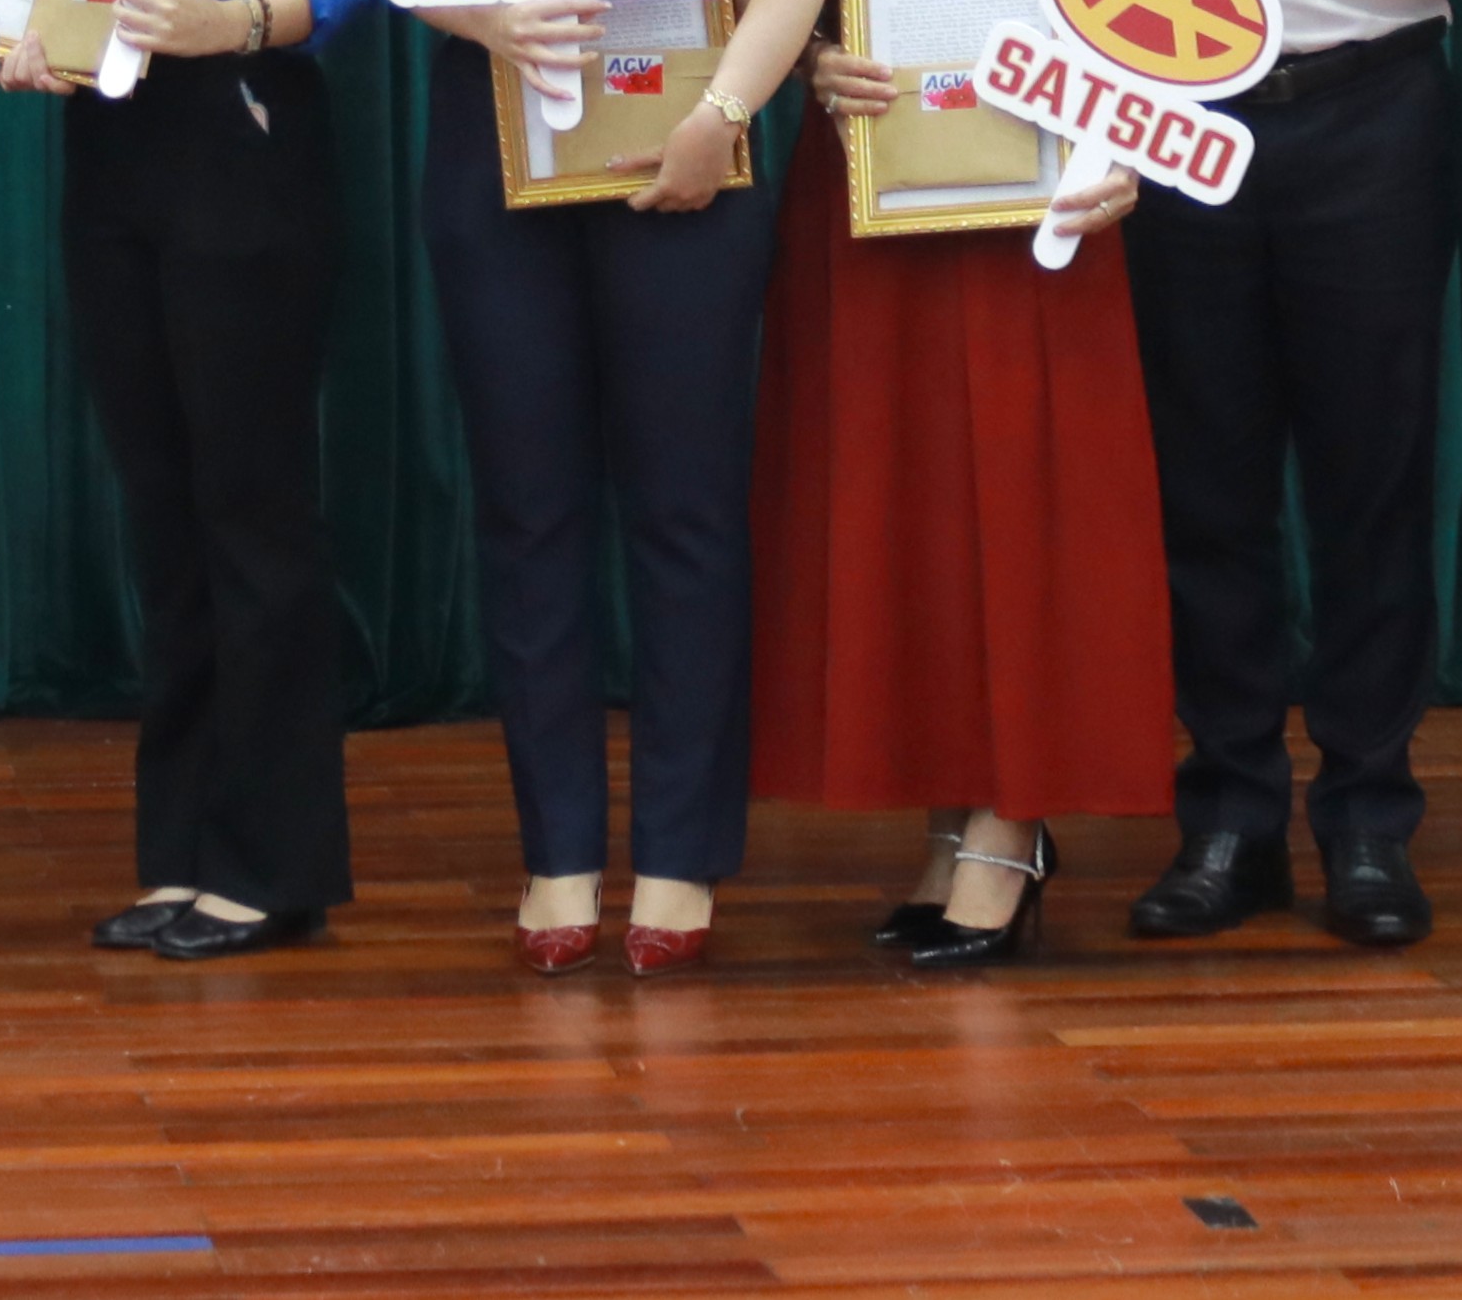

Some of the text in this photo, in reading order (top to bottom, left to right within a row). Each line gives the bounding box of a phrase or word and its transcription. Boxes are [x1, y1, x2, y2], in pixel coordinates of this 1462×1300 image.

[607, 57, 652, 74] ACV
[924, 72, 968, 91] ACV
[988, 37, 1237, 190] SATSCO
